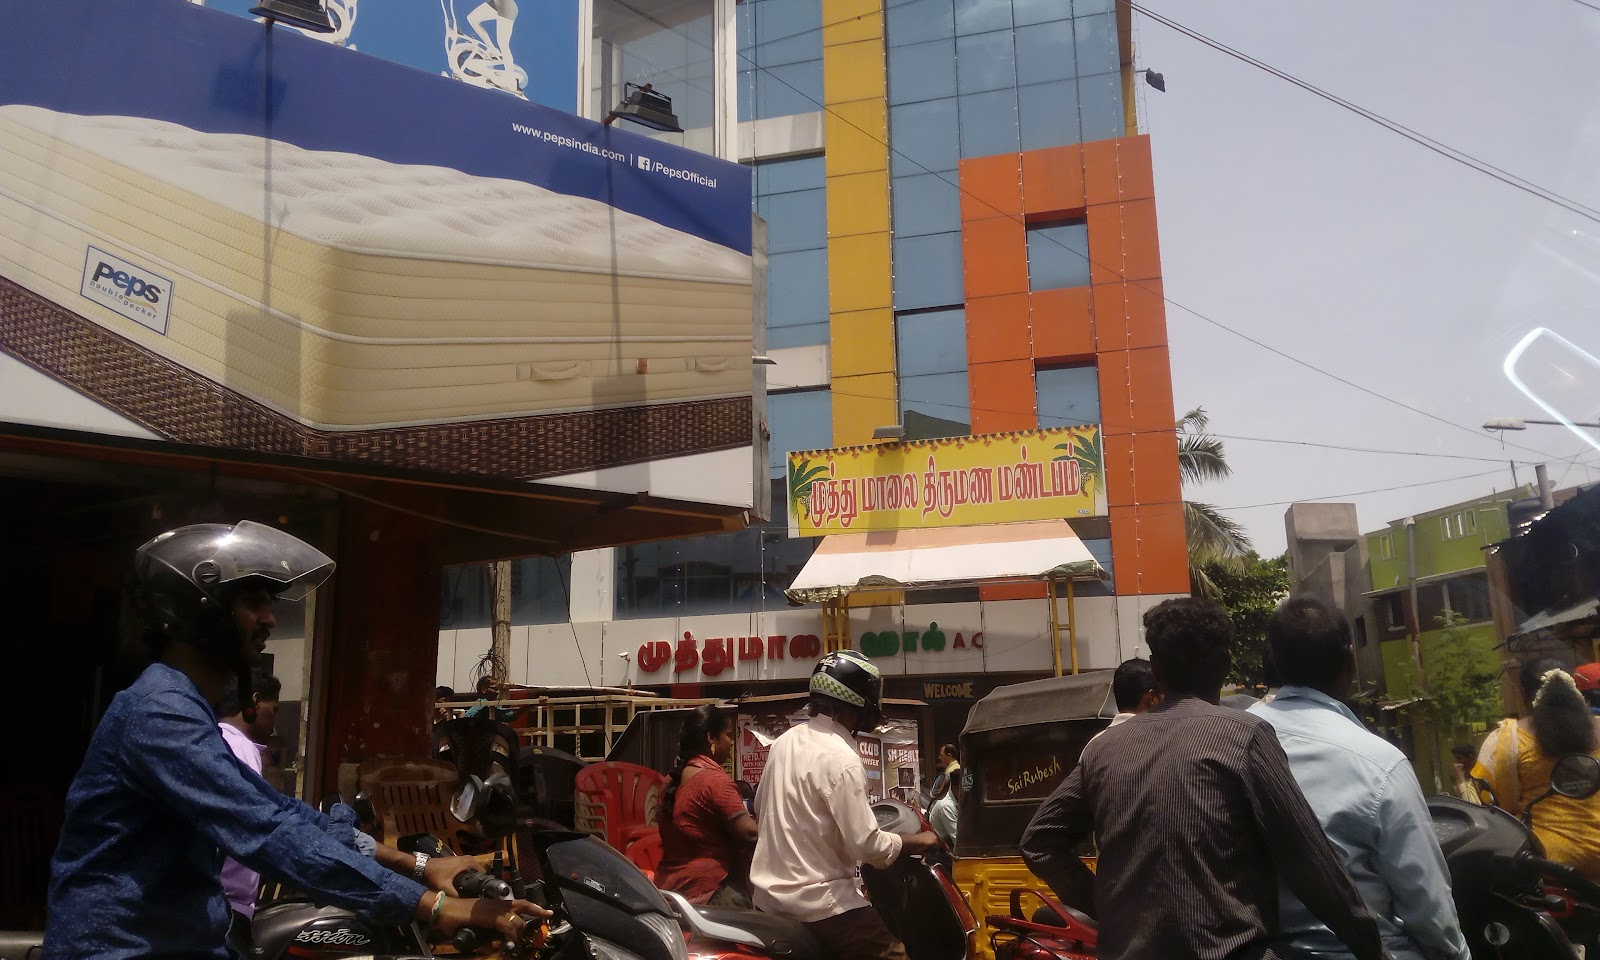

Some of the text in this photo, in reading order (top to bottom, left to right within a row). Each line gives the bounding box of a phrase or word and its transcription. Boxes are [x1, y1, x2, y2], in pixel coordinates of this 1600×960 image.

[512, 122, 625, 163] www.pepsindia.com
[810, 441, 1081, 528] முத்து மாலை திருமண மண்டபம்
[923, 682, 975, 699] WELCOME
